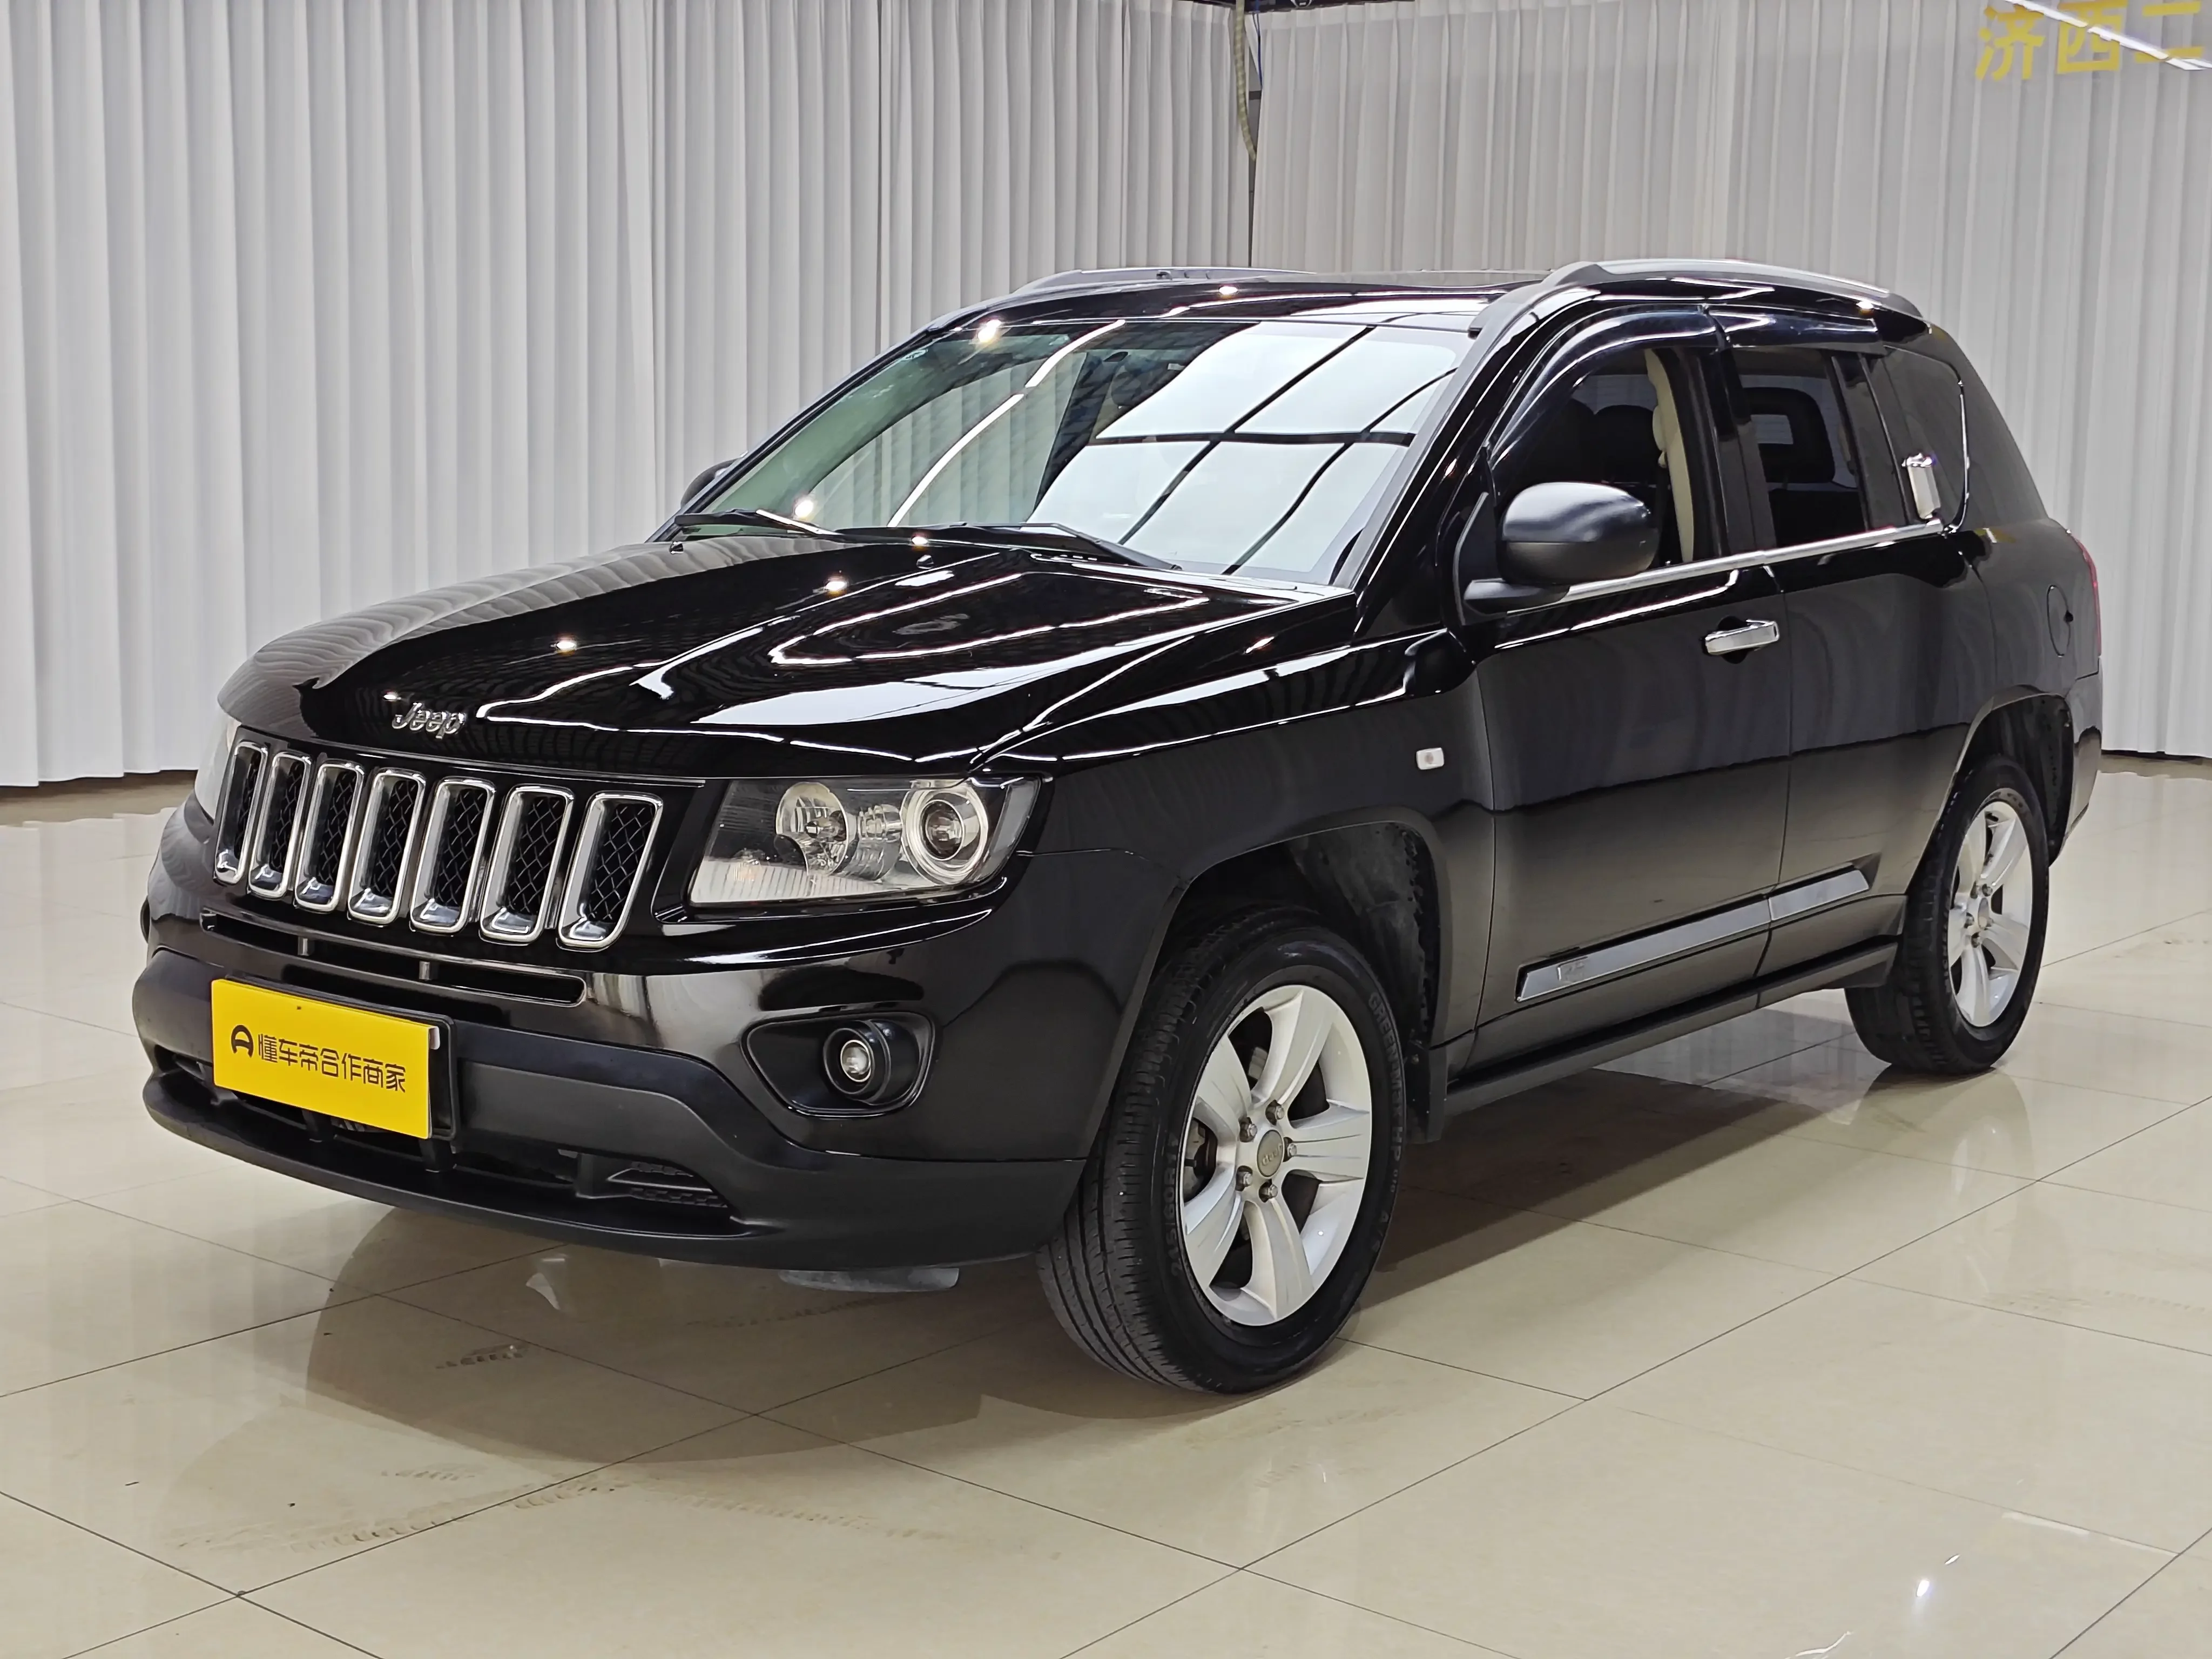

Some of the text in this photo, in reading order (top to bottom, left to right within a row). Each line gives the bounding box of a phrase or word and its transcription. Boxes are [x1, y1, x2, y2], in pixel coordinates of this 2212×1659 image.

[392, 702, 467, 736] Jeep
[258, 1034, 406, 1093] 懂车帝合作商家
